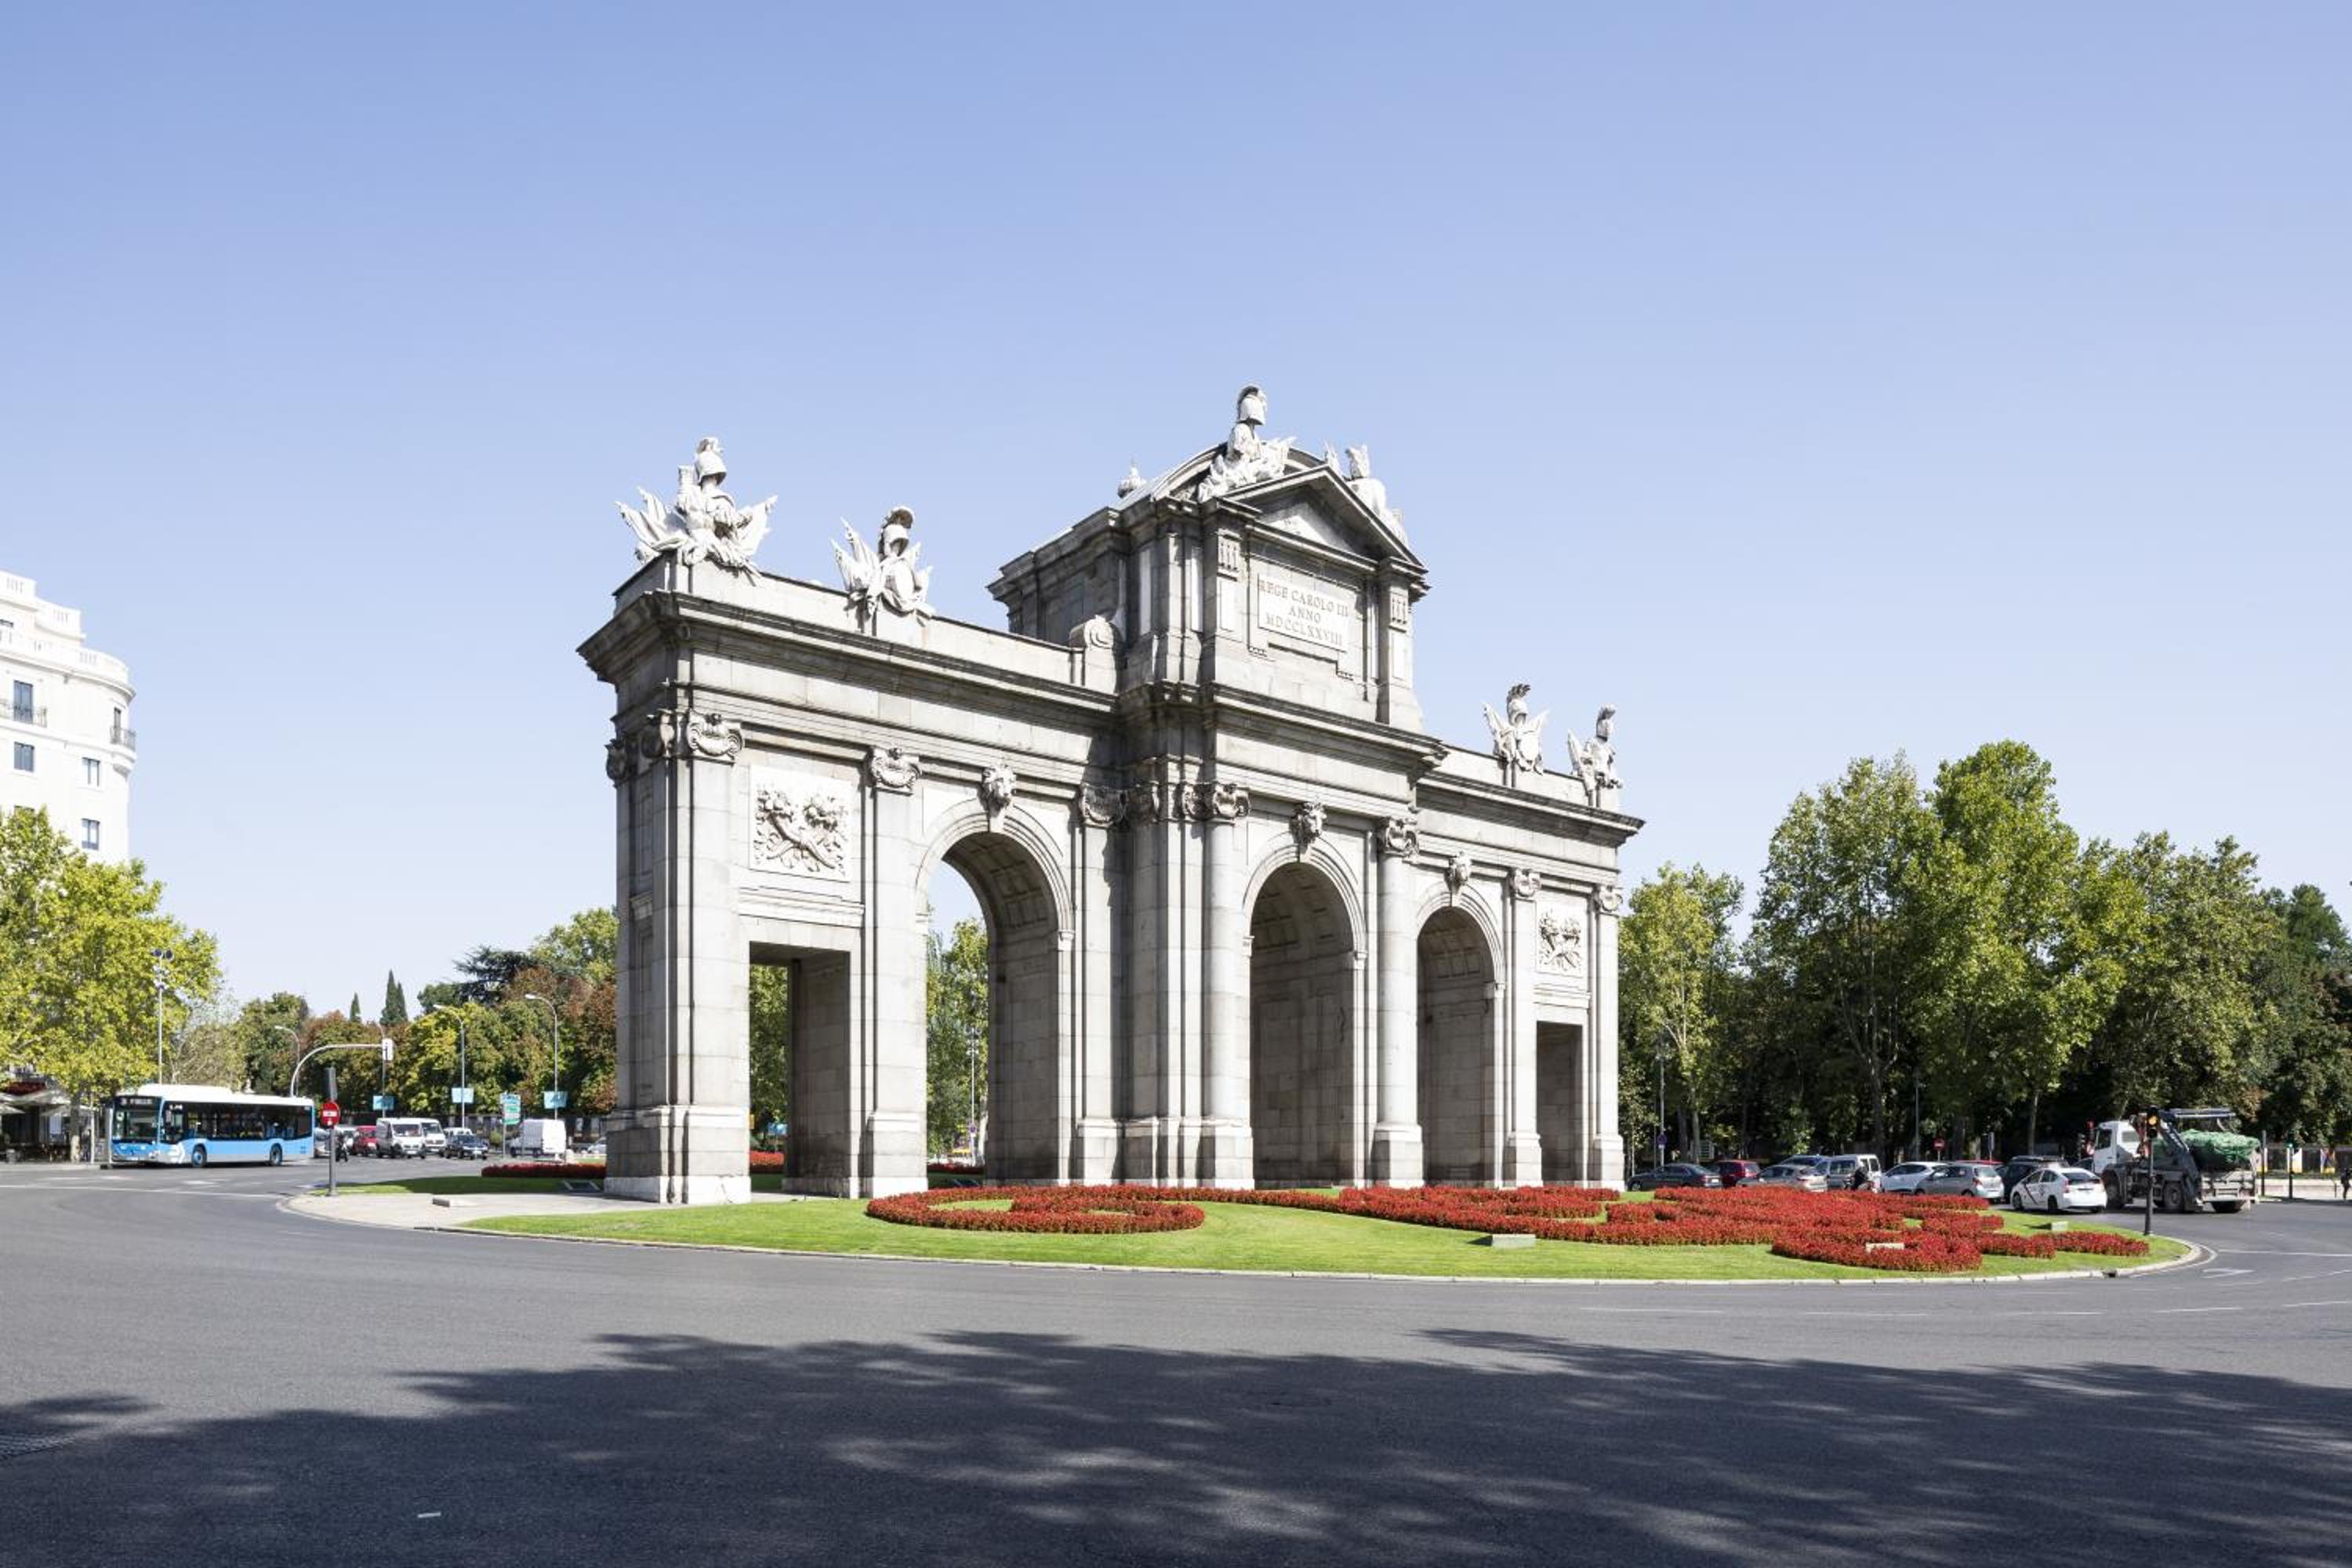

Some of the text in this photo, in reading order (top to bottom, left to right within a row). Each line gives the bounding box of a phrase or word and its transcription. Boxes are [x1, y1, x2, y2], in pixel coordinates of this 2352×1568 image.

[1259, 579, 1348, 617] REGE CAROLO III
[1288, 606, 1321, 623] ANNO
